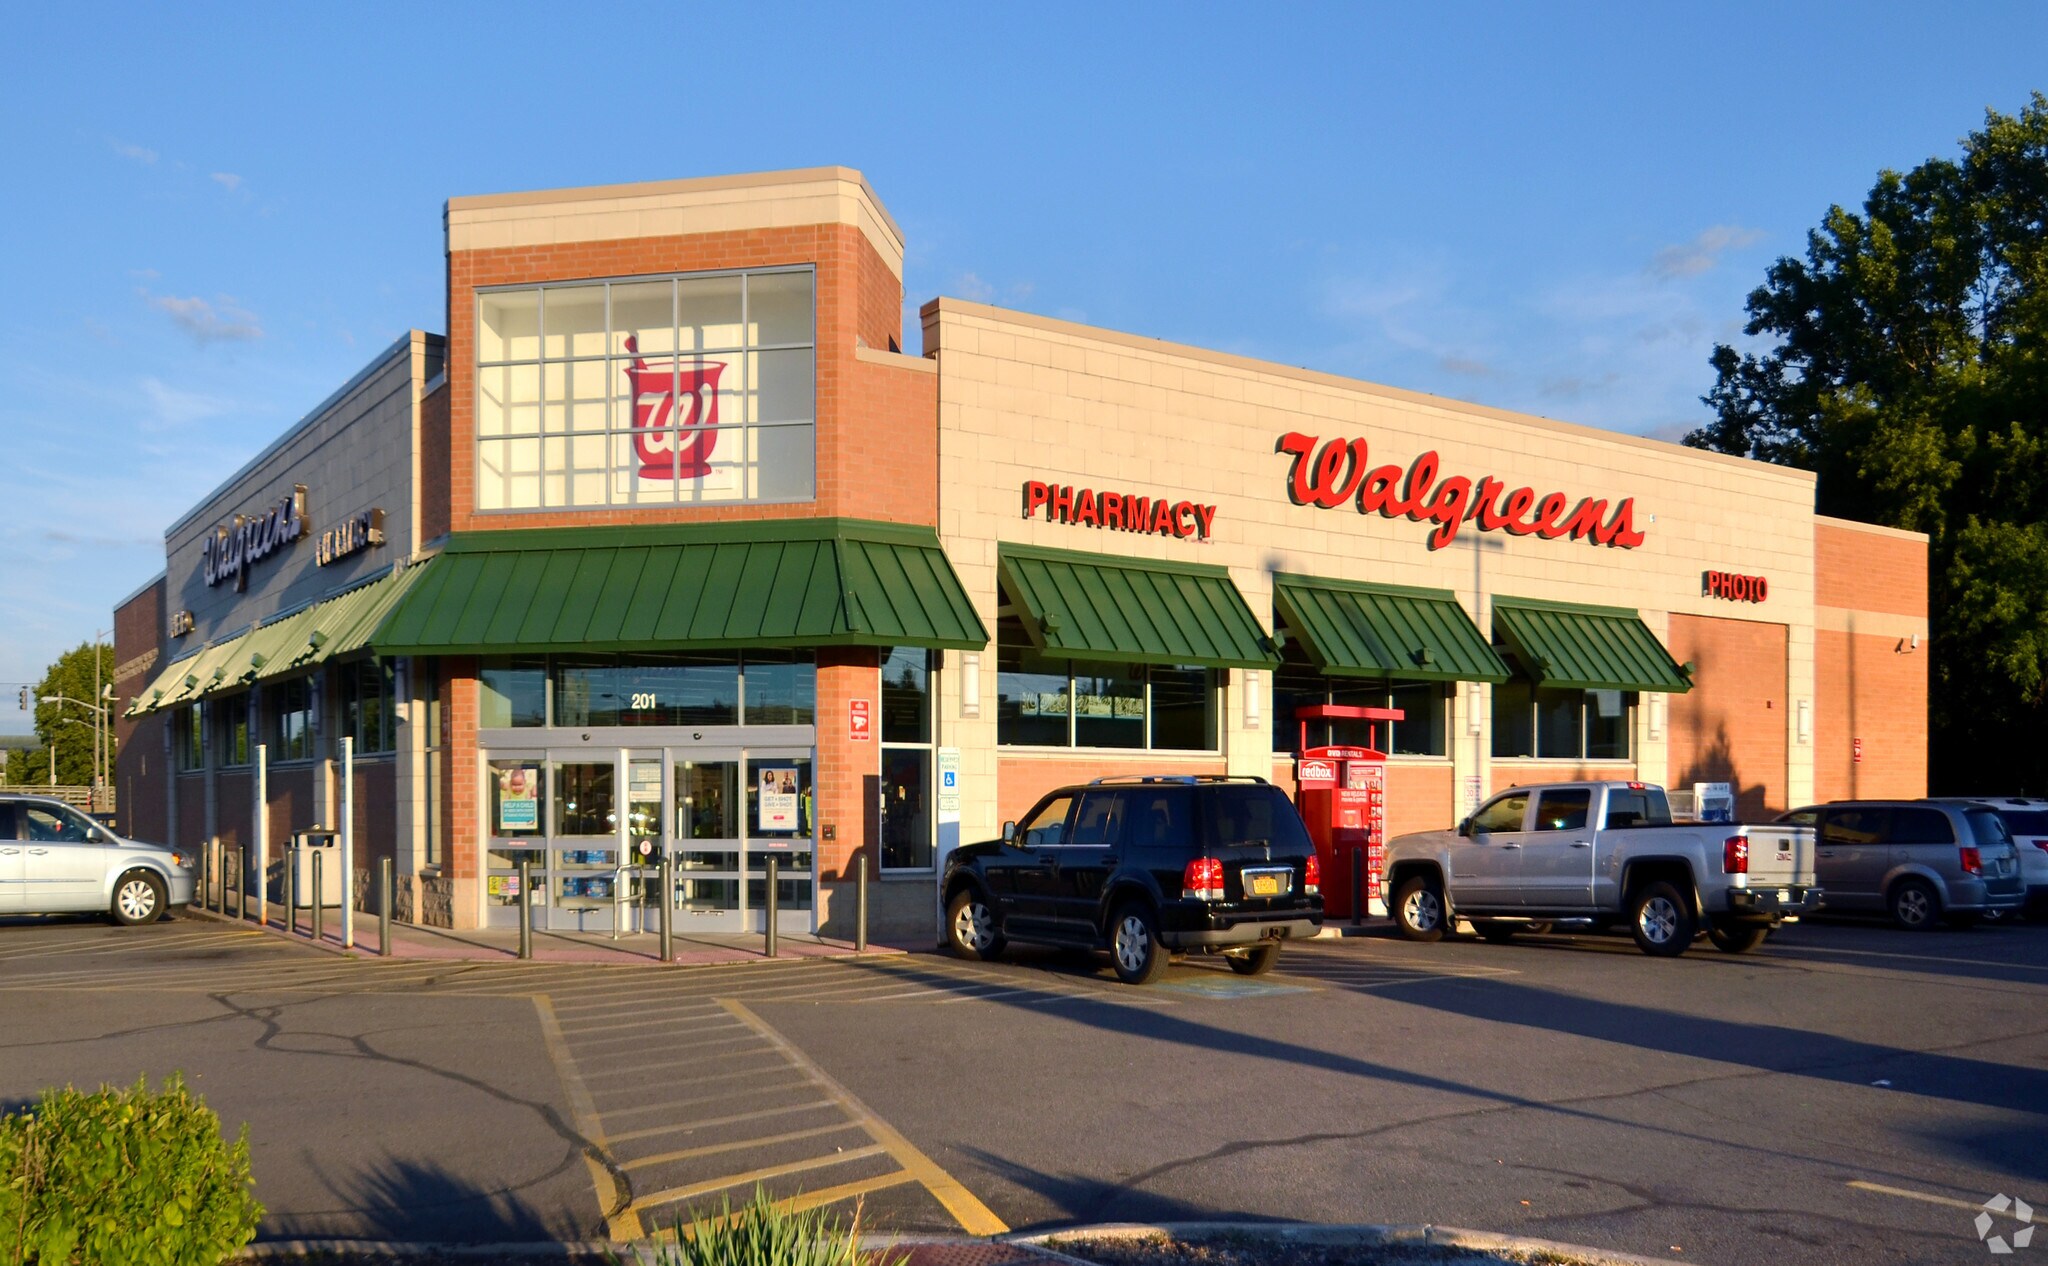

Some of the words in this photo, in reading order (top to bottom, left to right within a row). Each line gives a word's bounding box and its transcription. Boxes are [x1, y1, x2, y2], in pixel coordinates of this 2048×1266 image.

[1275, 432, 1645, 551] Walgreens
[1022, 480, 1217, 540] PHARMACY
[1702, 569, 1768, 604] PHOTO
[631, 693, 656, 709] 201
[1327, 749, 1341, 757] DVD
[1341, 750, 1363, 758] RENTALS
[1301, 765, 1332, 778] redbox
[1776, 853, 1792, 861] GMC
